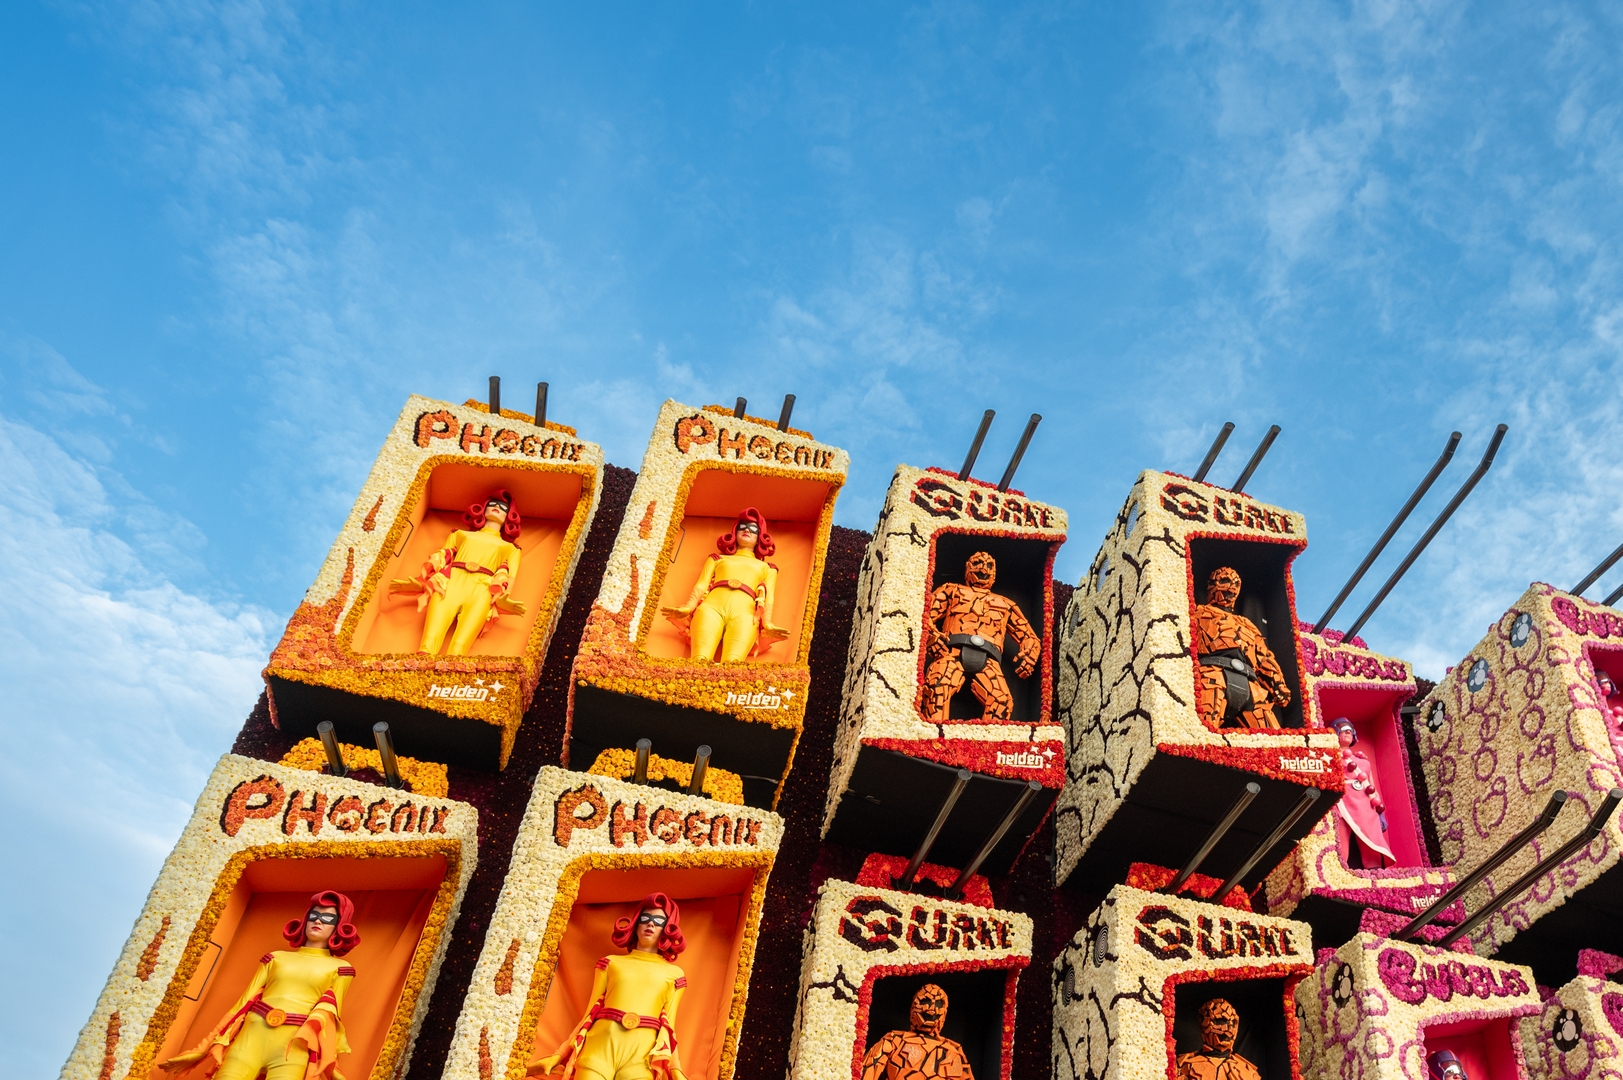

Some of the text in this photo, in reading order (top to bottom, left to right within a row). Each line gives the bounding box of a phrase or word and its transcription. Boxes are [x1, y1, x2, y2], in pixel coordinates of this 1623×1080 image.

[414, 410, 585, 462] PHOENIX
[674, 414, 834, 470] PHOENIX
[910, 477, 1054, 529] QUAKE
[1160, 482, 1295, 534] QUAKE
[428, 684, 489, 701] helden
[725, 691, 781, 709] helden
[996, 751, 1044, 767] helden
[1279, 755, 1324, 773] helden
[220, 774, 450, 838] PHOENIX
[553, 783, 762, 848] PHOENIX
[838, 895, 1013, 953] QUAKE
[1133, 905, 1299, 961] QUAKE
